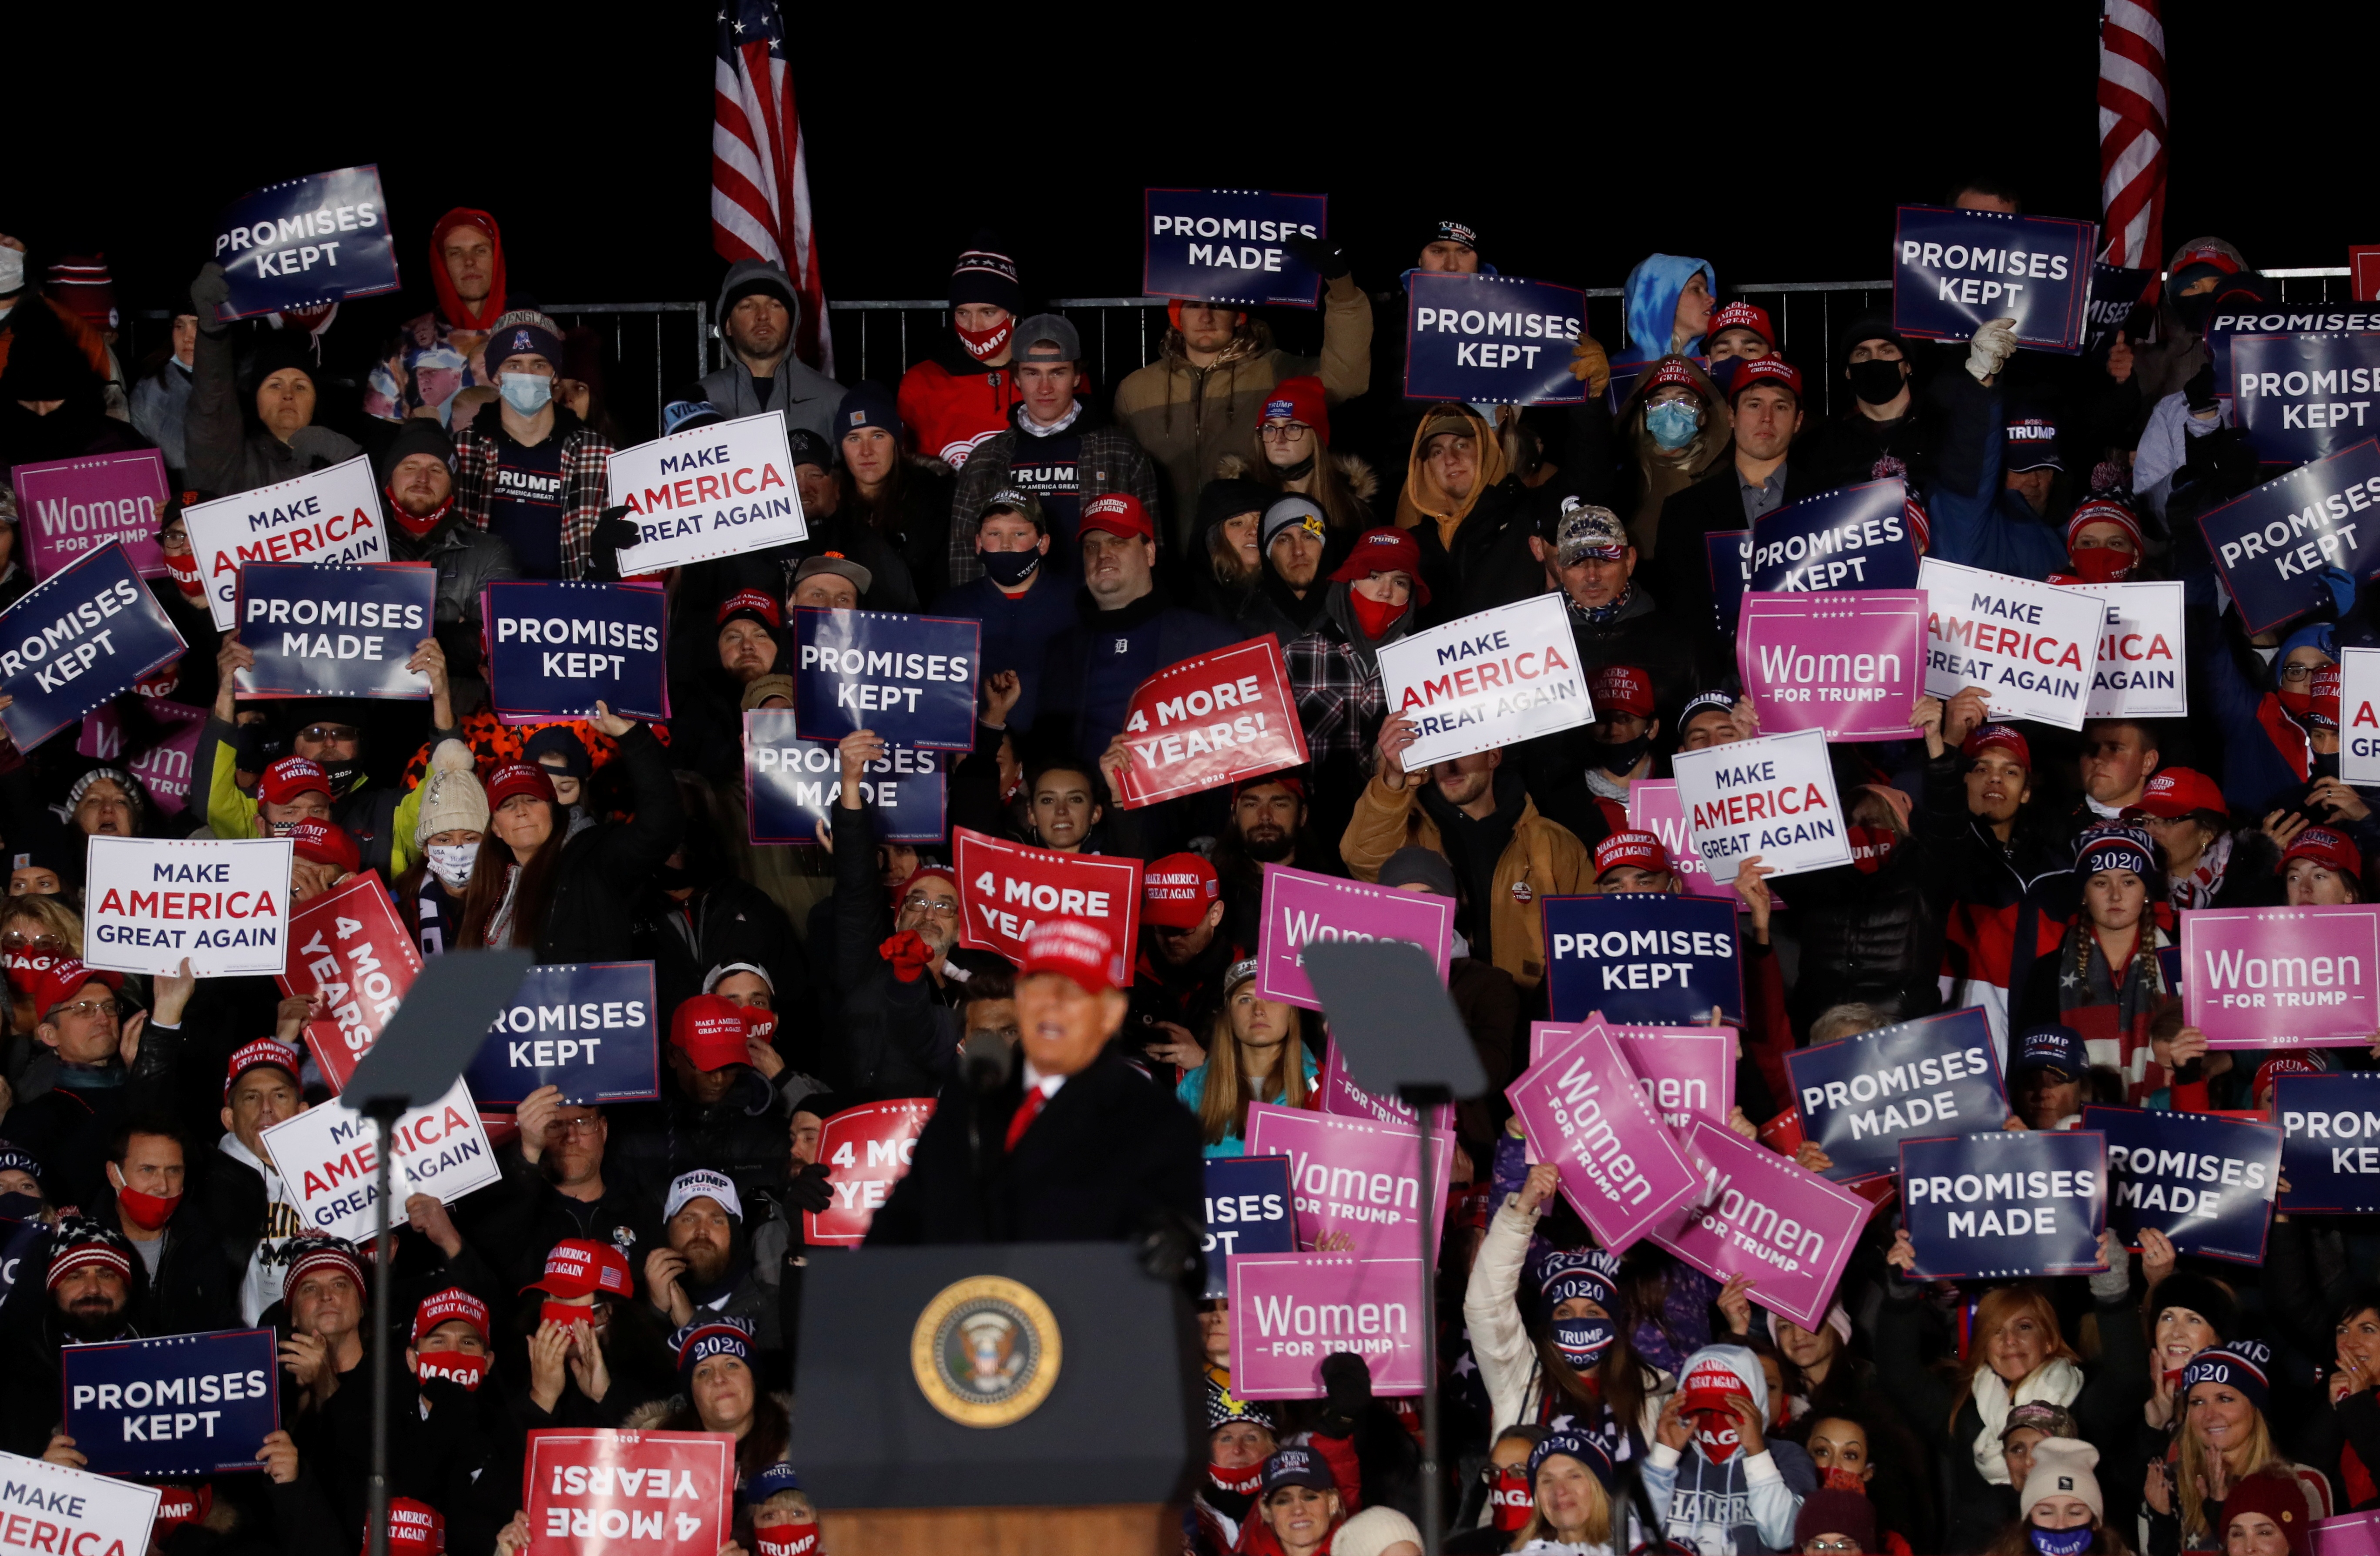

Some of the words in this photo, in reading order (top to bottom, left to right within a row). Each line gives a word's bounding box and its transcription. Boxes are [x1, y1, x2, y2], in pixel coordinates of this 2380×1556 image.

[216, 202, 377, 257] PROMISES
[1439, 221, 1476, 238] Trump
[256, 241, 339, 278] KEPT
[1188, 244, 1282, 272] MADE
[1902, 241, 2068, 280] PROMISES
[1724, 301, 1750, 309] KEEP
[1939, 277, 2023, 308] KEPT
[1417, 308, 1581, 340] PROMISES
[1715, 309, 1758, 324] AMERICA
[2214, 314, 2380, 331] PROMISES
[959, 329, 1007, 355] TRUMP
[1457, 343, 1541, 369] KEPT
[1659, 373, 1692, 383] GREAT
[1766, 361, 1793, 375] AMERICA
[1772, 368, 1791, 379] AGAIN
[2283, 402, 2370, 429] KEPT
[2006, 426, 2055, 439] TRUMP
[660, 445, 730, 476] MAKE
[506, 488, 531, 498] AMERICA
[532, 492, 554, 501] GREAT!
[620, 463, 785, 520] AMERICA
[1099, 499, 1128, 509] AMERICA
[36, 495, 156, 536] Women
[248, 496, 321, 532] MAKE
[641, 515, 703, 545] REAT
[713, 497, 791, 531] AGAIN
[1085, 507, 1103, 518] GREAT
[1104, 506, 1124, 514] AGAIN
[2219, 476, 2380, 570] PROMISES
[1369, 535, 1400, 545] Trump
[1565, 518, 1611, 538] TRUMP
[56, 537, 89, 553] FOR
[213, 507, 374, 578] AMERICA
[1754, 517, 1903, 572] PROMISES
[2274, 523, 2359, 581] KEPT
[1786, 557, 1866, 592] KEPT
[246, 598, 423, 630] PROMISES
[748, 600, 768, 610] AGAIN
[1971, 593, 2043, 625] MAKE
[282, 632, 383, 661] MADE
[497, 618, 658, 652] PROMISES
[1437, 630, 1510, 666] MAKE
[1928, 612, 2082, 672] AMERICA
[34, 629, 116, 694] KEPT
[543, 652, 625, 681] KEPT
[801, 645, 969, 682] PROMISES
[1603, 669, 1629, 678] KEEP
[1760, 645, 1900, 684] Women
[1401, 646, 1569, 711] AMERICA
[1594, 680, 1638, 691] AMERICA
[1998, 667, 2080, 700] AGAIN
[2091, 671, 2174, 690] AGAIN
[838, 683, 922, 713] KEPT
[1126, 709, 1148, 733] 4
[1156, 675, 1262, 728] MORE
[1497, 680, 1577, 718] AGAIN
[1598, 689, 1631, 700] GREAT
[1774, 688, 1810, 703] FOR
[1819, 687, 1887, 703] TRUMP
[1133, 713, 1267, 770] YEARS!
[274, 758, 317, 772] MICHIGAN
[279, 768, 319, 781] TRUMP
[1201, 772, 1225, 785] 2020
[1716, 761, 1776, 789] MAKE
[1693, 783, 1827, 832] AMERICA
[1597, 837, 1617, 856] MAKE
[1617, 833, 1657, 845] AMERICA
[1702, 833, 1750, 860] GREAT
[1760, 819, 1835, 850] AGAIN
[1602, 850, 1627, 866] GREAT
[1627, 848, 1652, 858] AGAIN
[2091, 852, 2142, 873] 2020
[153, 864, 230, 882] MAKE
[1145, 873, 1161, 885] MAKE
[1161, 873, 1200, 885] AMERICA
[97, 889, 277, 919] AMERICA
[976, 872, 995, 897] 4
[1004, 876, 1110, 918] MORE
[1148, 888, 1168, 899] GREAT
[1169, 888, 1196, 900] AGAIN
[96, 925, 186, 949] GREAT
[194, 928, 276, 949] AGAIN
[336, 916, 362, 941] 4
[1554, 931, 1732, 959] PROMISES
[1602, 962, 1693, 991] KEPT
[2205, 949, 2360, 989] Women
[300, 930, 372, 1063] YEARS!
[2222, 993, 2265, 1009] FOR
[2273, 992, 2347, 1007] TRUMP
[698, 1026, 722, 1035] GREAT
[2025, 1034, 2069, 1047] TRUMP
[232, 1048, 256, 1066] MAKE
[256, 1043, 293, 1062] AMERICA
[237, 1053, 265, 1070] GREAT
[509, 1038, 601, 1068] KEPT
[1344, 1081, 1368, 1108] FOR
[1803, 1047, 1988, 1116] PROMISES
[1849, 1091, 1958, 1140] MADE
[1556, 1056, 1652, 1206] Women
[406, 1137, 482, 1182] AGAIN
[831, 1141, 856, 1169] 4
[1548, 1096, 1576, 1134] FOR
[1571, 1139, 1621, 1203] TRUMP
[676, 1174, 728, 1189] TRUMP
[1908, 1170, 2095, 1206] PROMISES
[1328, 1202, 1400, 1225] TRUMP
[1695, 1158, 1825, 1259] Women
[2114, 1182, 2222, 1220] MADE
[1948, 1207, 2057, 1239] MADE
[558, 1246, 591, 1263] AMERICA
[1734, 1229, 1799, 1274] TRUMP
[556, 1262, 584, 1277] AGAIN
[423, 1292, 448, 1309] MAKE
[448, 1290, 486, 1312] AMERICA
[1552, 1280, 1605, 1304] 2020
[426, 1303, 455, 1318] GREAT
[456, 1304, 482, 1321] AGAIN
[1254, 1295, 1407, 1337] Women
[694, 1336, 746, 1361] 2020
[1272, 1341, 1314, 1357] FOR
[1558, 1328, 1604, 1345] TRUMP
[74, 1370, 267, 1411] PROMISES
[1713, 1375, 1741, 1389] AGAIN
[123, 1411, 221, 1442] KEPT
[613, 1435, 640, 1444] 2020
[552, 1465, 700, 1500] YEARS!
[2, 1481, 86, 1518] MAKE
[391, 1510, 433, 1527] AMERICA
[546, 1508, 662, 1540] MORE
[675, 1511, 702, 1541] 4
[396, 1528, 426, 1542] AGAIN
[758, 1534, 816, 1556] TRUMP
[2038, 1537, 2081, 1555] Trump
